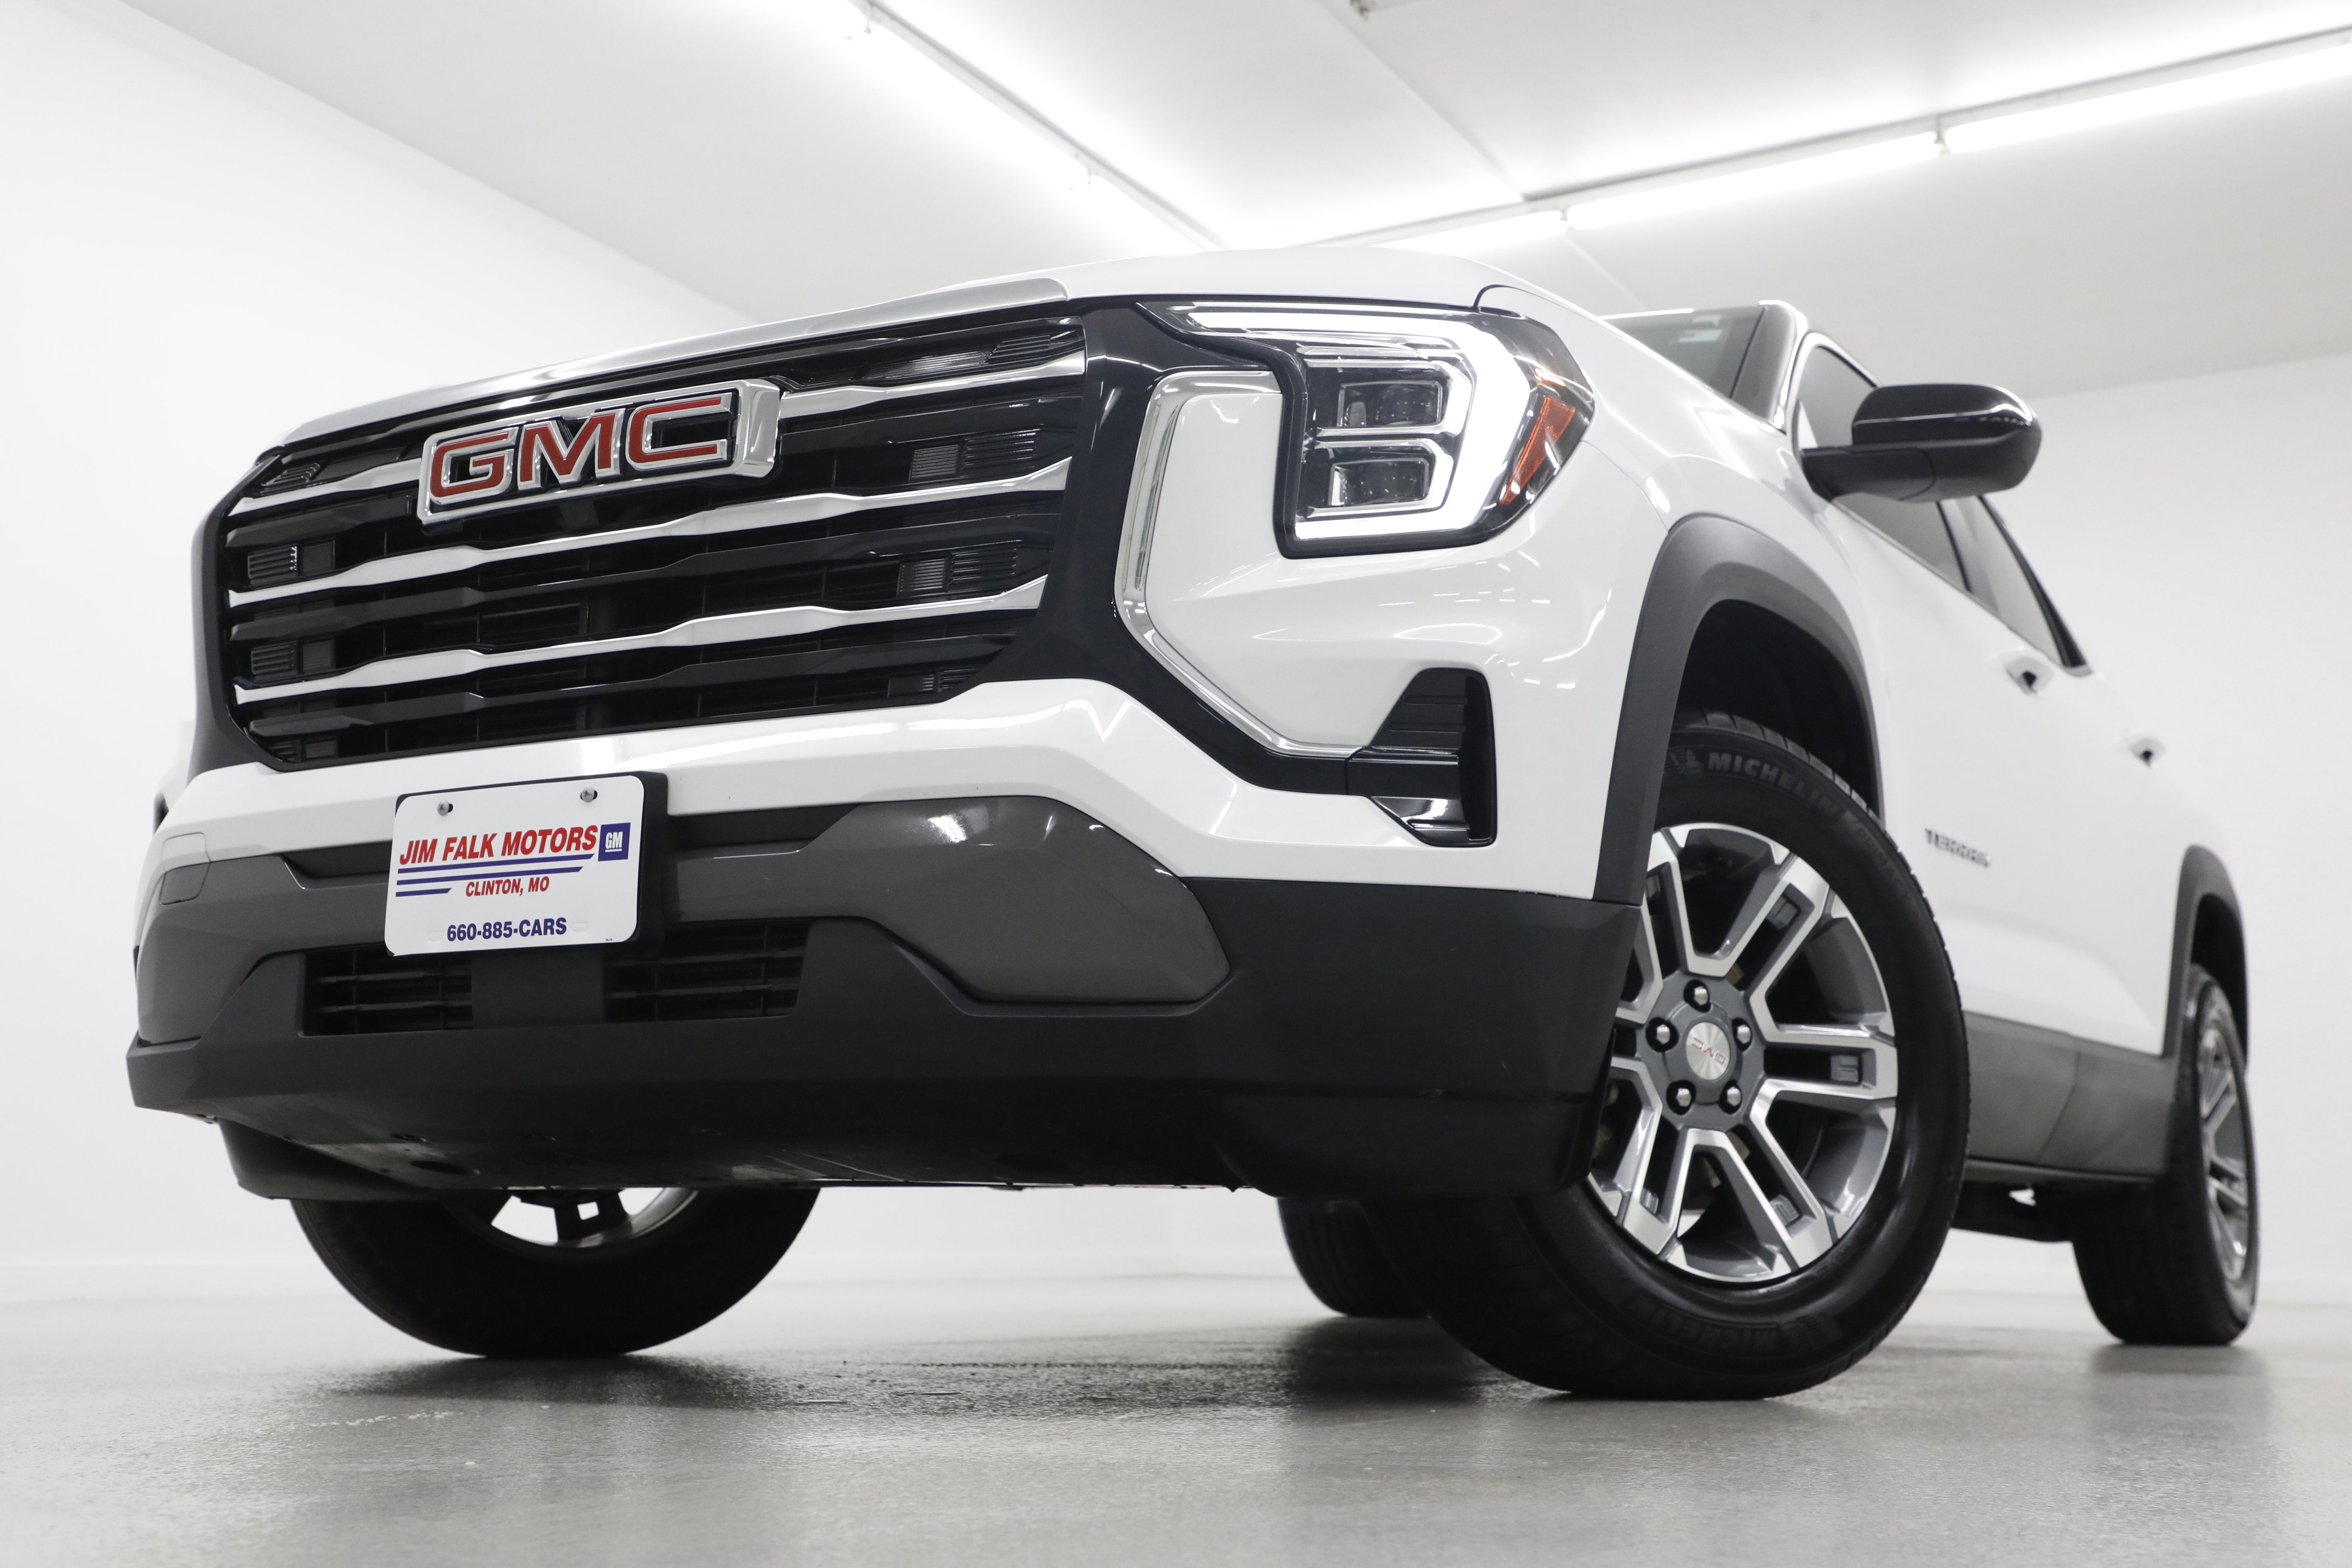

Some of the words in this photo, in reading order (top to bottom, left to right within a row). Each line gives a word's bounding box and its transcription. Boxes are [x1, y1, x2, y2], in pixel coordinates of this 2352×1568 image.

[430, 391, 733, 506] GMC
[1707, 751, 1840, 817] MICHELIN
[400, 839, 438, 865] JIM
[442, 833, 497, 861] FALK
[501, 825, 598, 856] MOTORS
[605, 831, 623, 849] GM
[466, 878, 523, 897] CLINTON,
[528, 876, 550, 893] MO
[447, 917, 567, 941] 660-885-CARS
[1691, 1037, 1726, 1065] GMC
